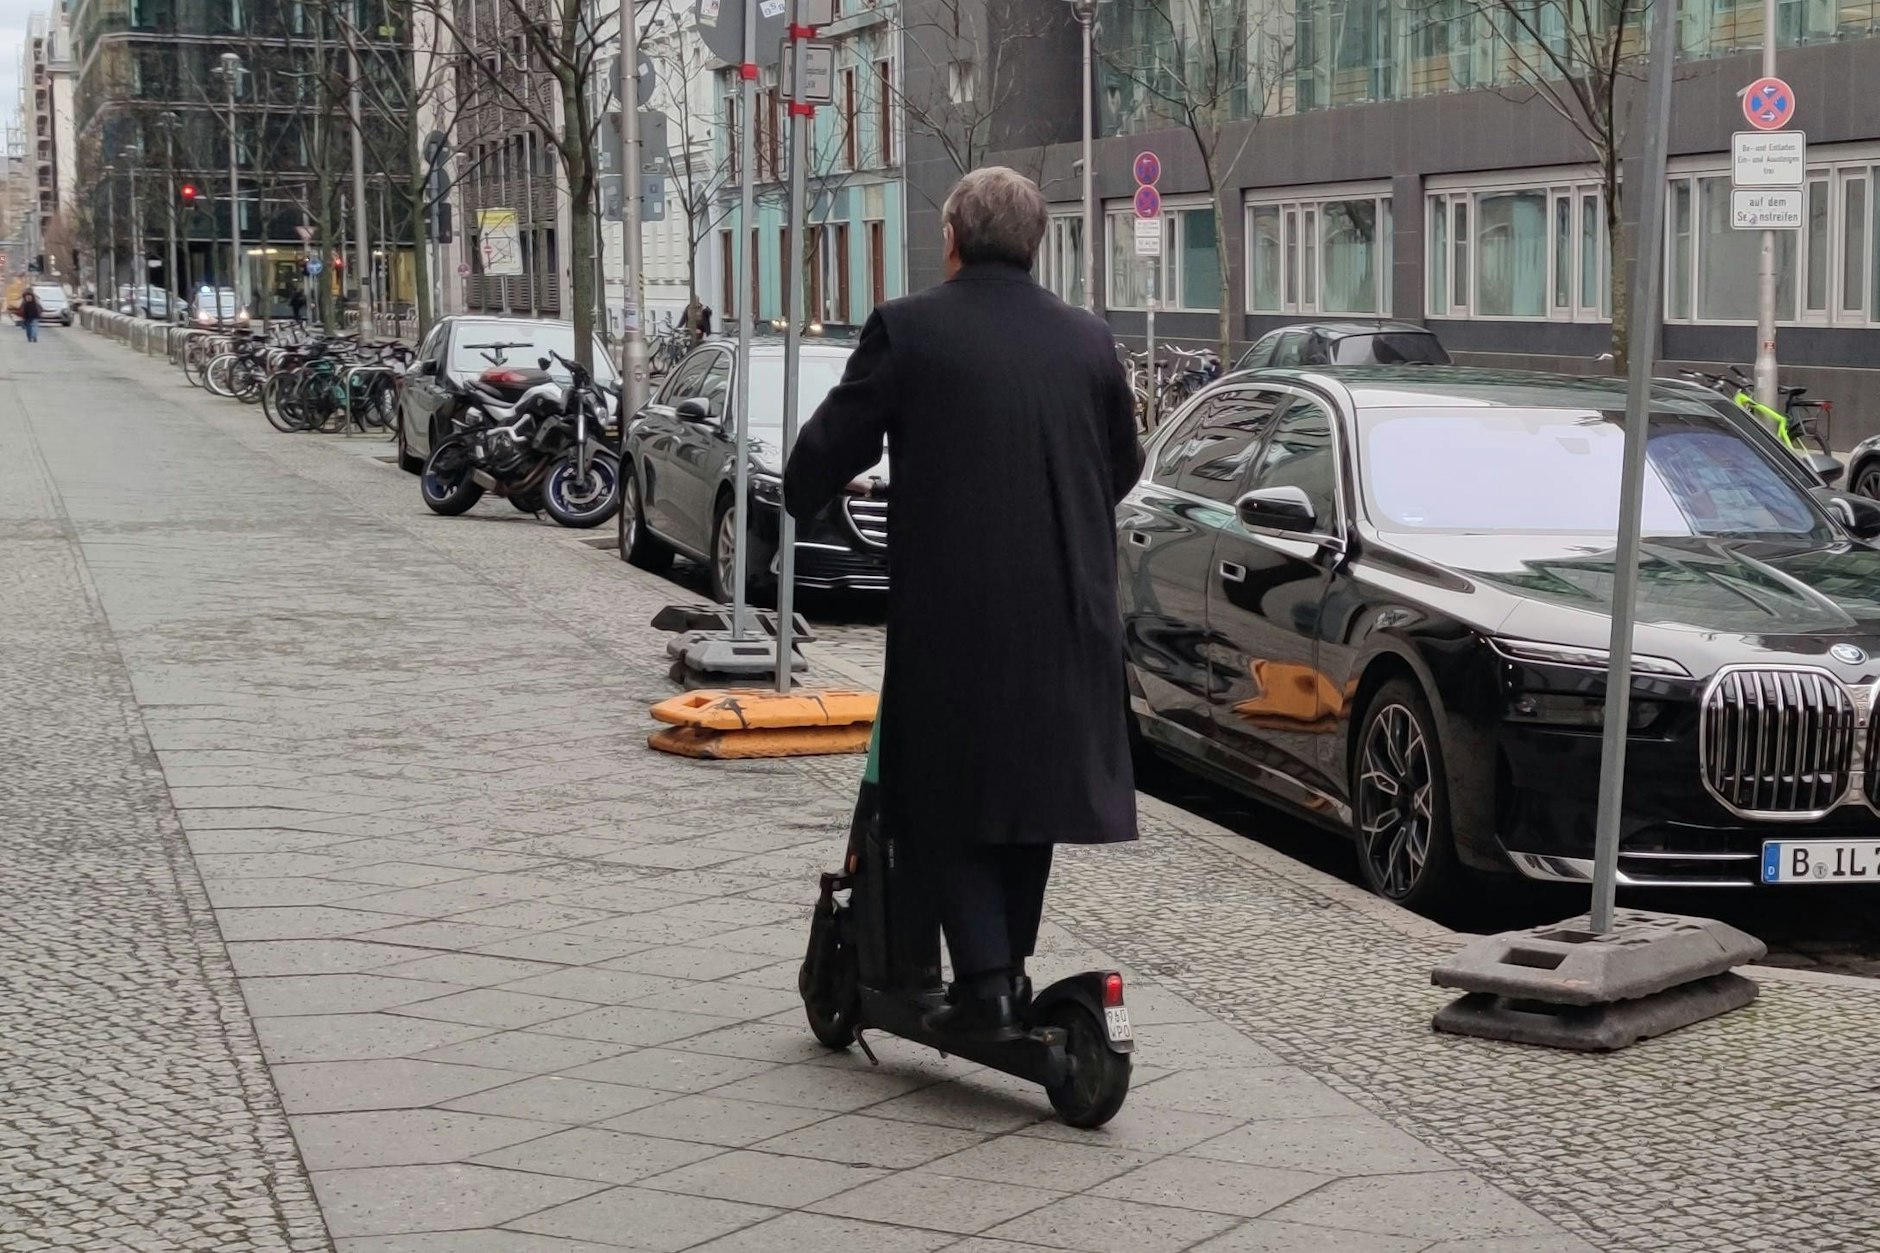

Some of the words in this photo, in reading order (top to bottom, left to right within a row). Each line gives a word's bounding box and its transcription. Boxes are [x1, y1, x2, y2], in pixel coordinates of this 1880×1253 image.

[1769, 143, 1796, 151] Entladen
[1749, 196, 1763, 207] auf
[1768, 196, 1787, 207] dem
[1792, 848, 1810, 877] B
